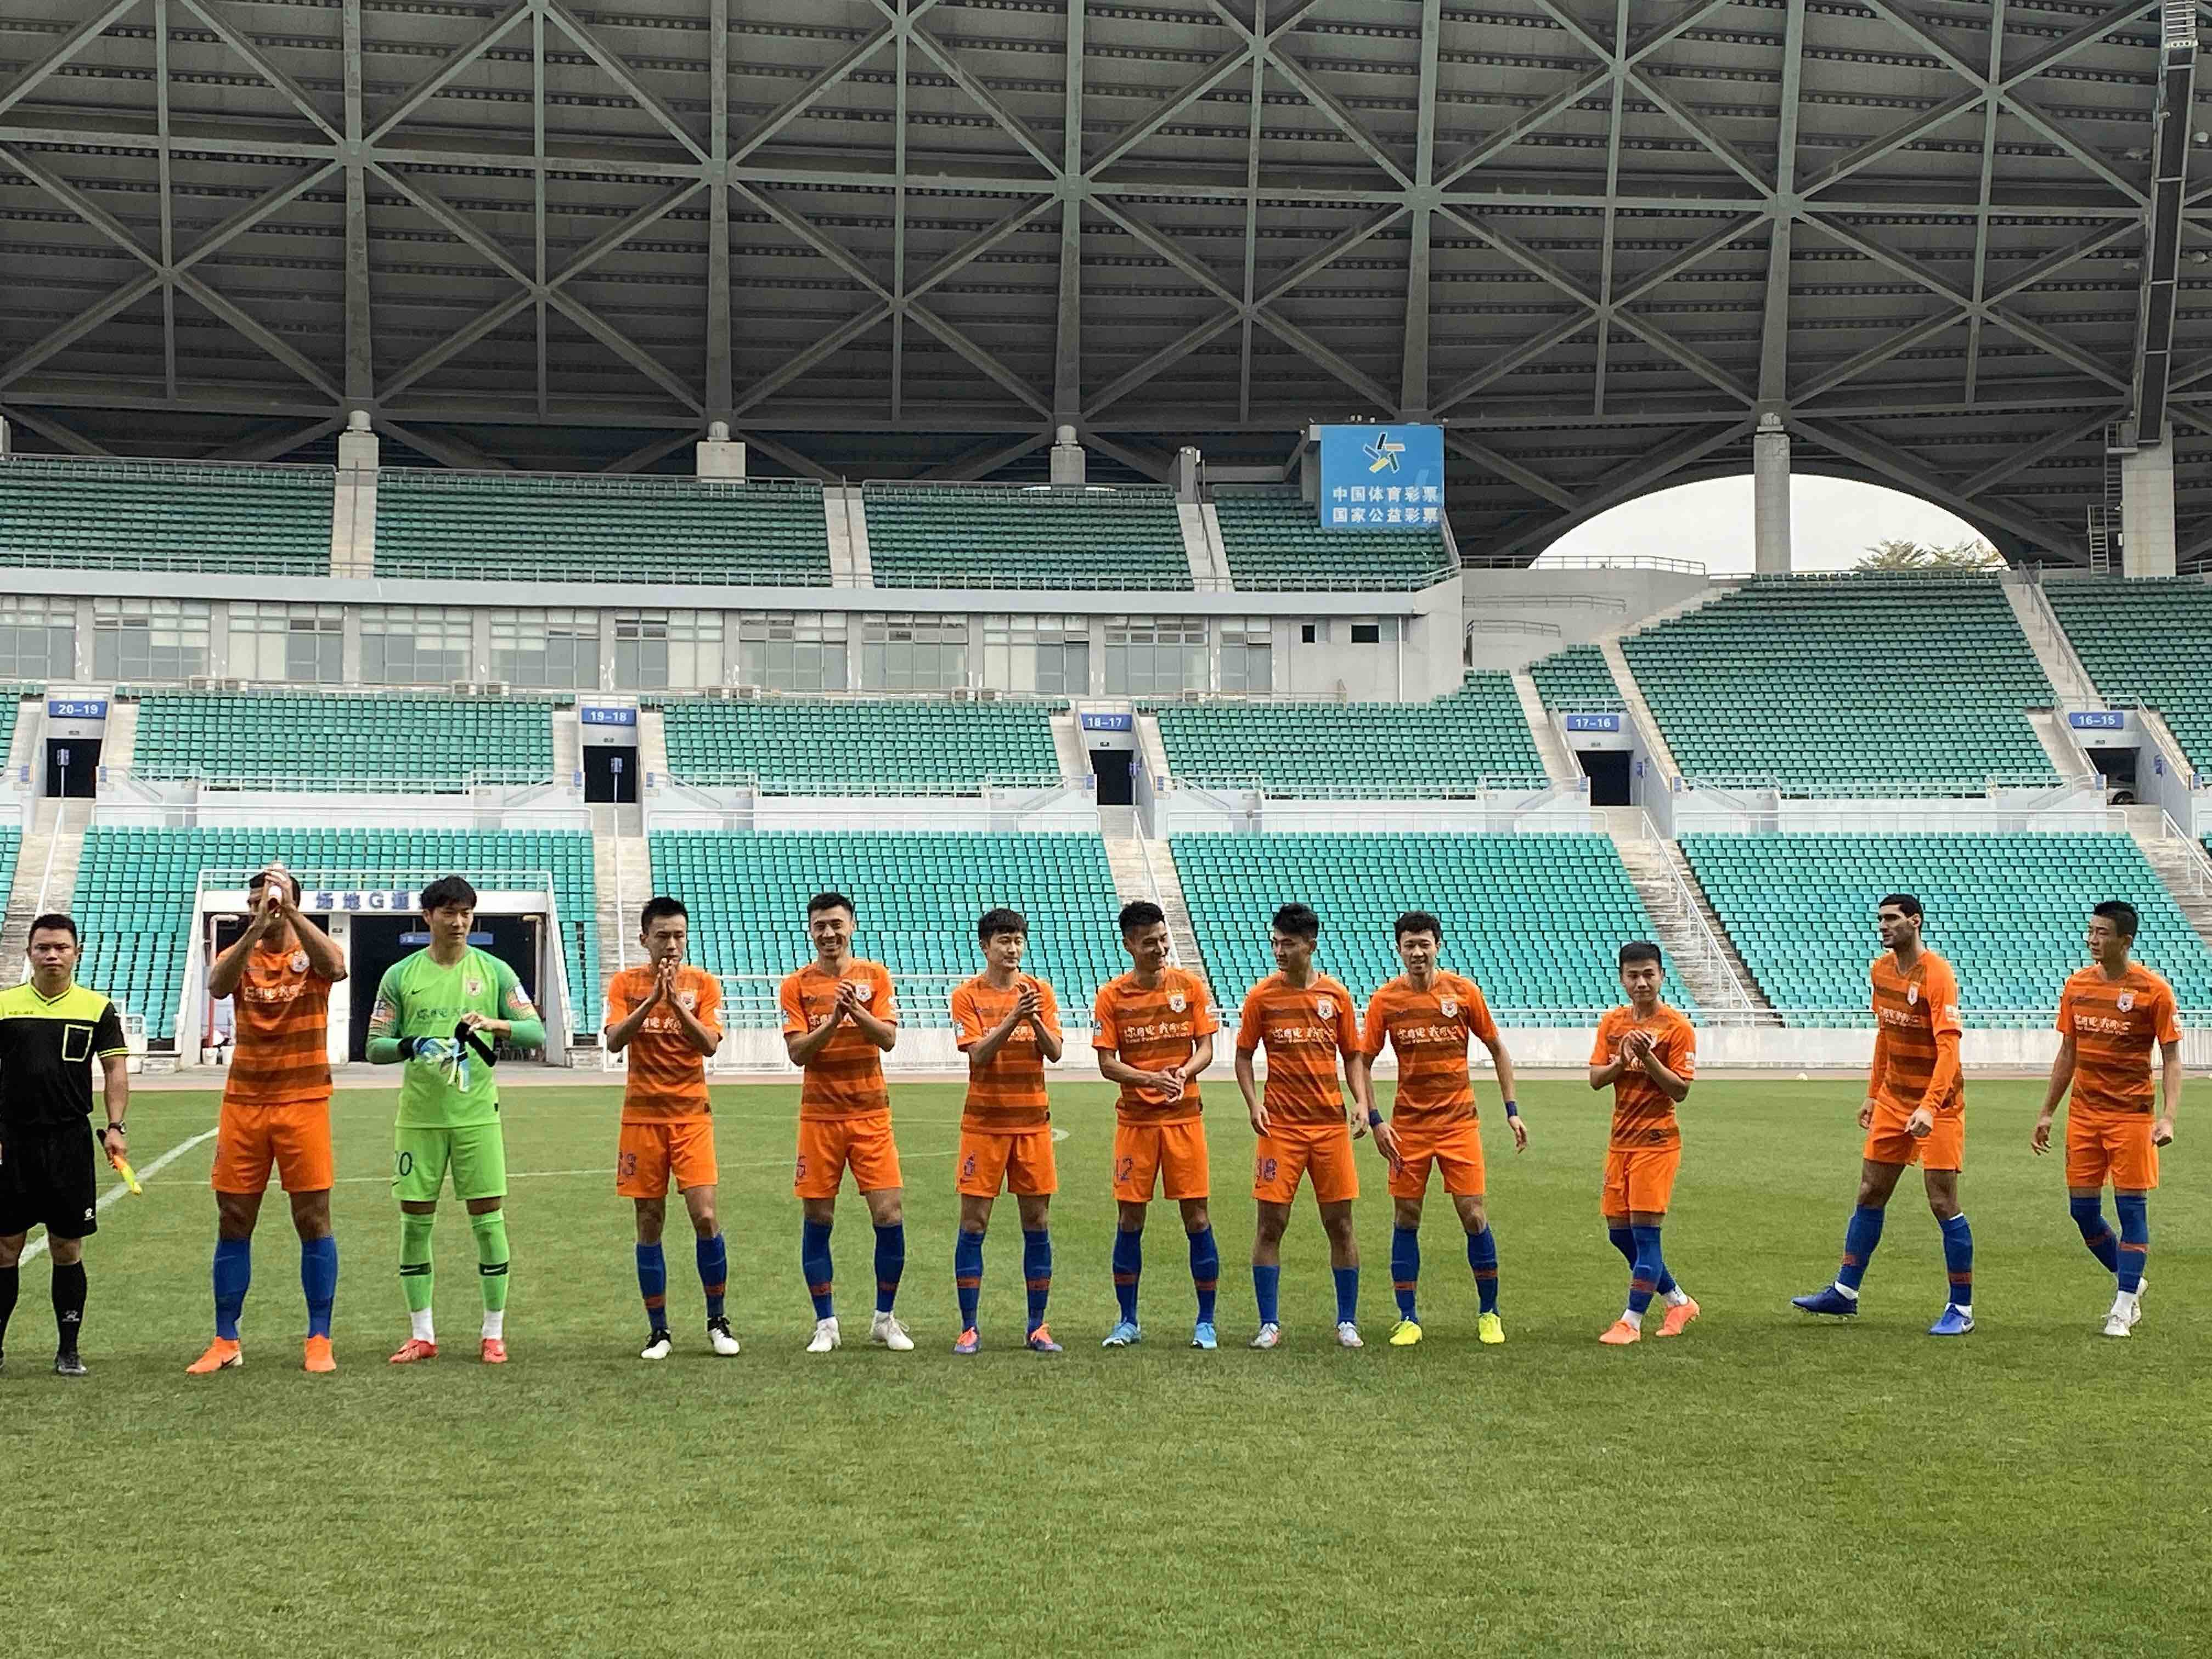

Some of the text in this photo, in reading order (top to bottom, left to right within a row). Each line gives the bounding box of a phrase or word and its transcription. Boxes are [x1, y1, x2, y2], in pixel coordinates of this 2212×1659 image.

[1333, 486, 1439, 502] 中国体育彩票
[1333, 507, 1439, 523] 国家公益彩票
[58, 704, 98, 714] 20-19
[591, 711, 627, 721] 19-18
[2079, 715, 2115, 725] 16-15
[1088, 717, 1122, 727] 18-17
[1576, 718, 1611, 728] 17-16
[316, 890, 422, 910] 场地G通
